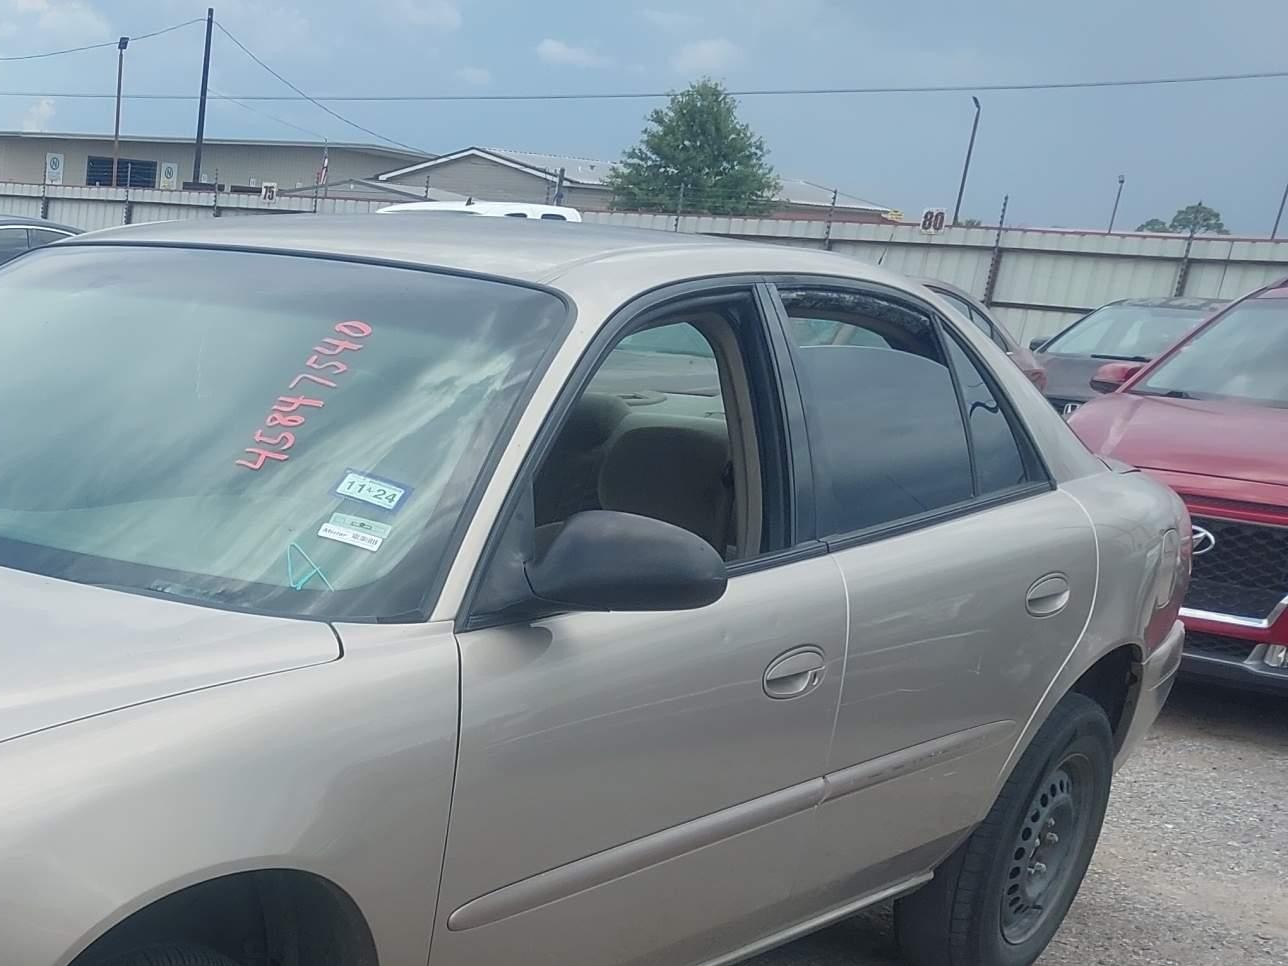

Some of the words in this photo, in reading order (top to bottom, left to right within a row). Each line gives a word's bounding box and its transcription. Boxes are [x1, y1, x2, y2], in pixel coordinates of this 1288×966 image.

[263, 185, 275, 200] 75
[922, 211, 945, 230] 80
[235, 320, 373, 471] 45847540
